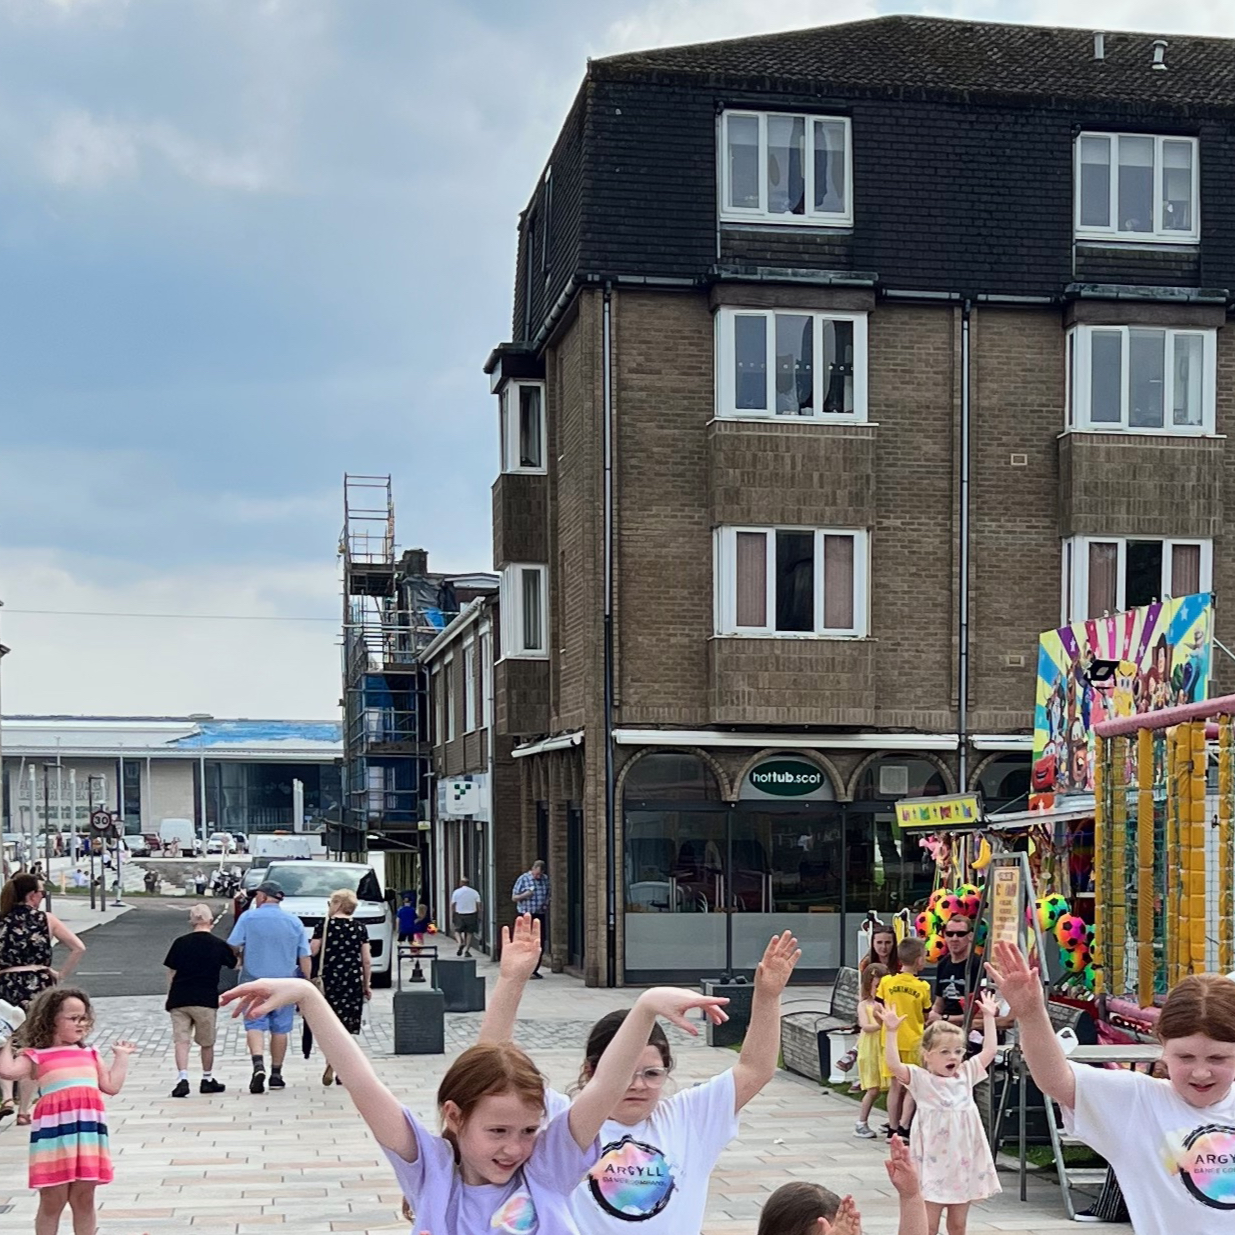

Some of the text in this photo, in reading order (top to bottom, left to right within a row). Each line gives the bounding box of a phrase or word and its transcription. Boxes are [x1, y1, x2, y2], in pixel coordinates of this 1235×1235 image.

[752, 771, 821, 784] hottub.scot
[94, 816, 109, 825] 30
[604, 1163, 664, 1178] ARGYLL
